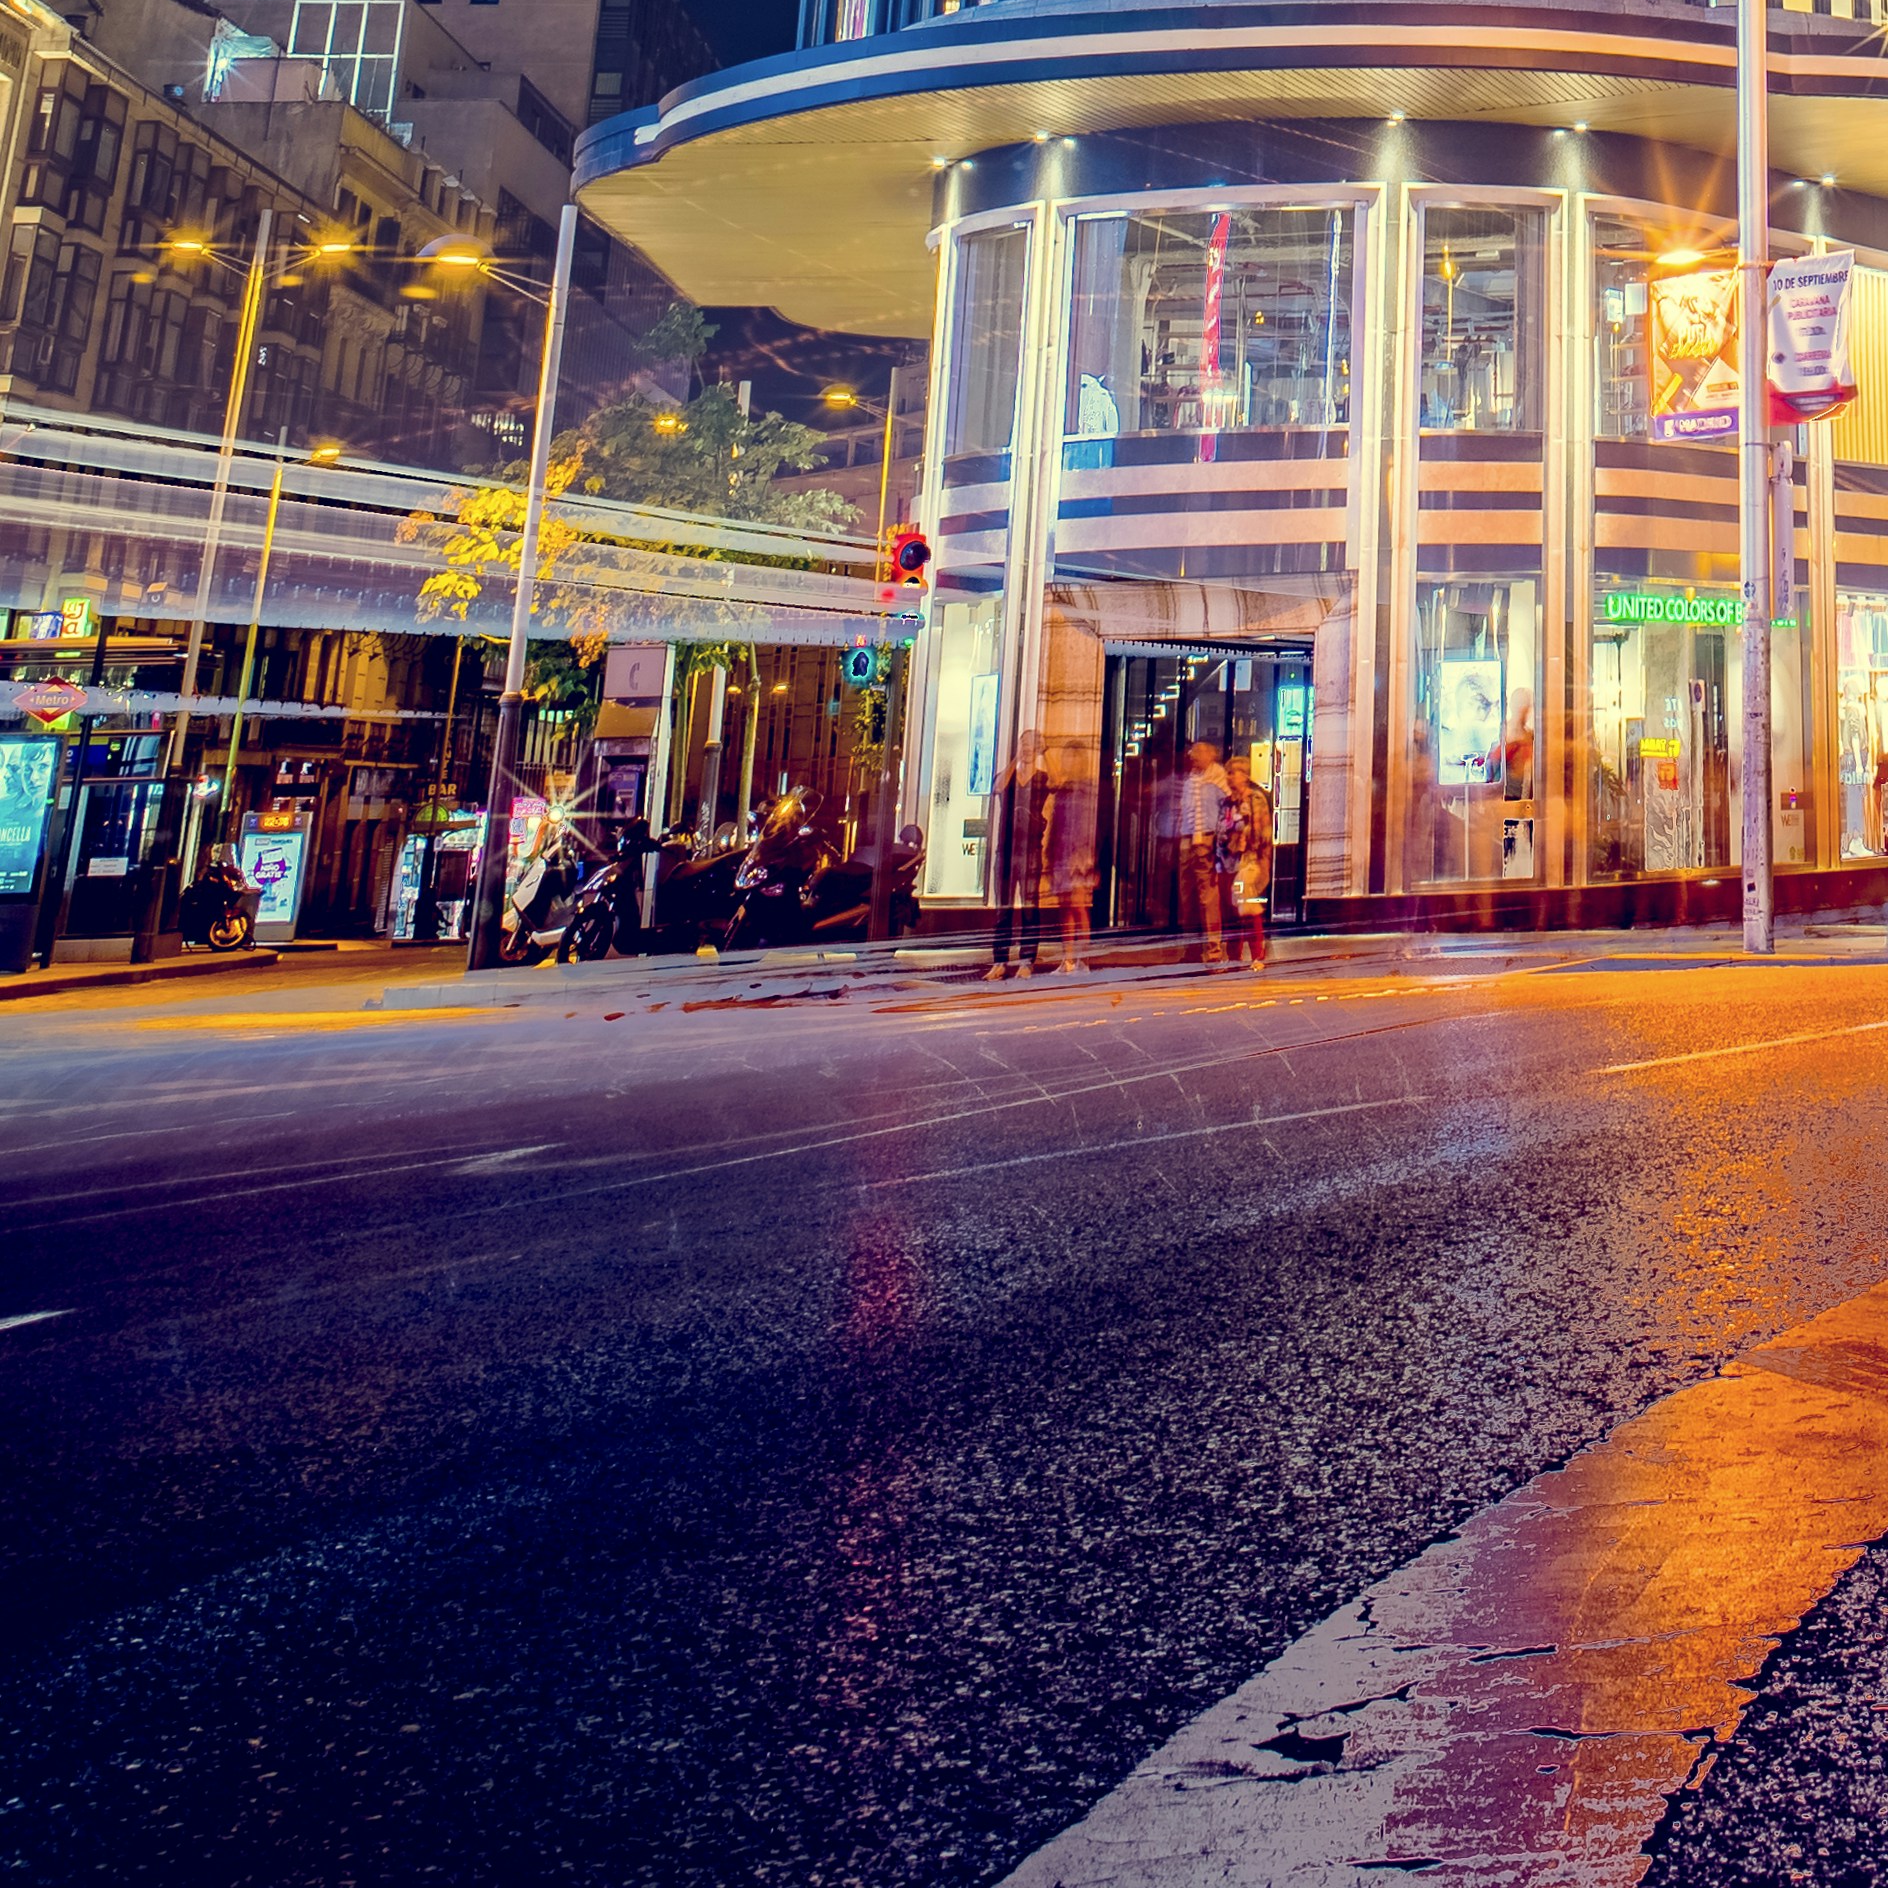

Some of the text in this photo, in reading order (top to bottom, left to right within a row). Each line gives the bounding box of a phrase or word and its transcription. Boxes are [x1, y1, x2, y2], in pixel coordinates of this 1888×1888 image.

[1773, 270, 1850, 291] 10 DE SEPTIEMBRE
[1608, 594, 1664, 620] UNITED
[1665, 598, 1715, 624] COLORS
[1716, 601, 1734, 624] OF
[35, 693, 70, 707] Metro
[427, 783, 458, 796] BAR
